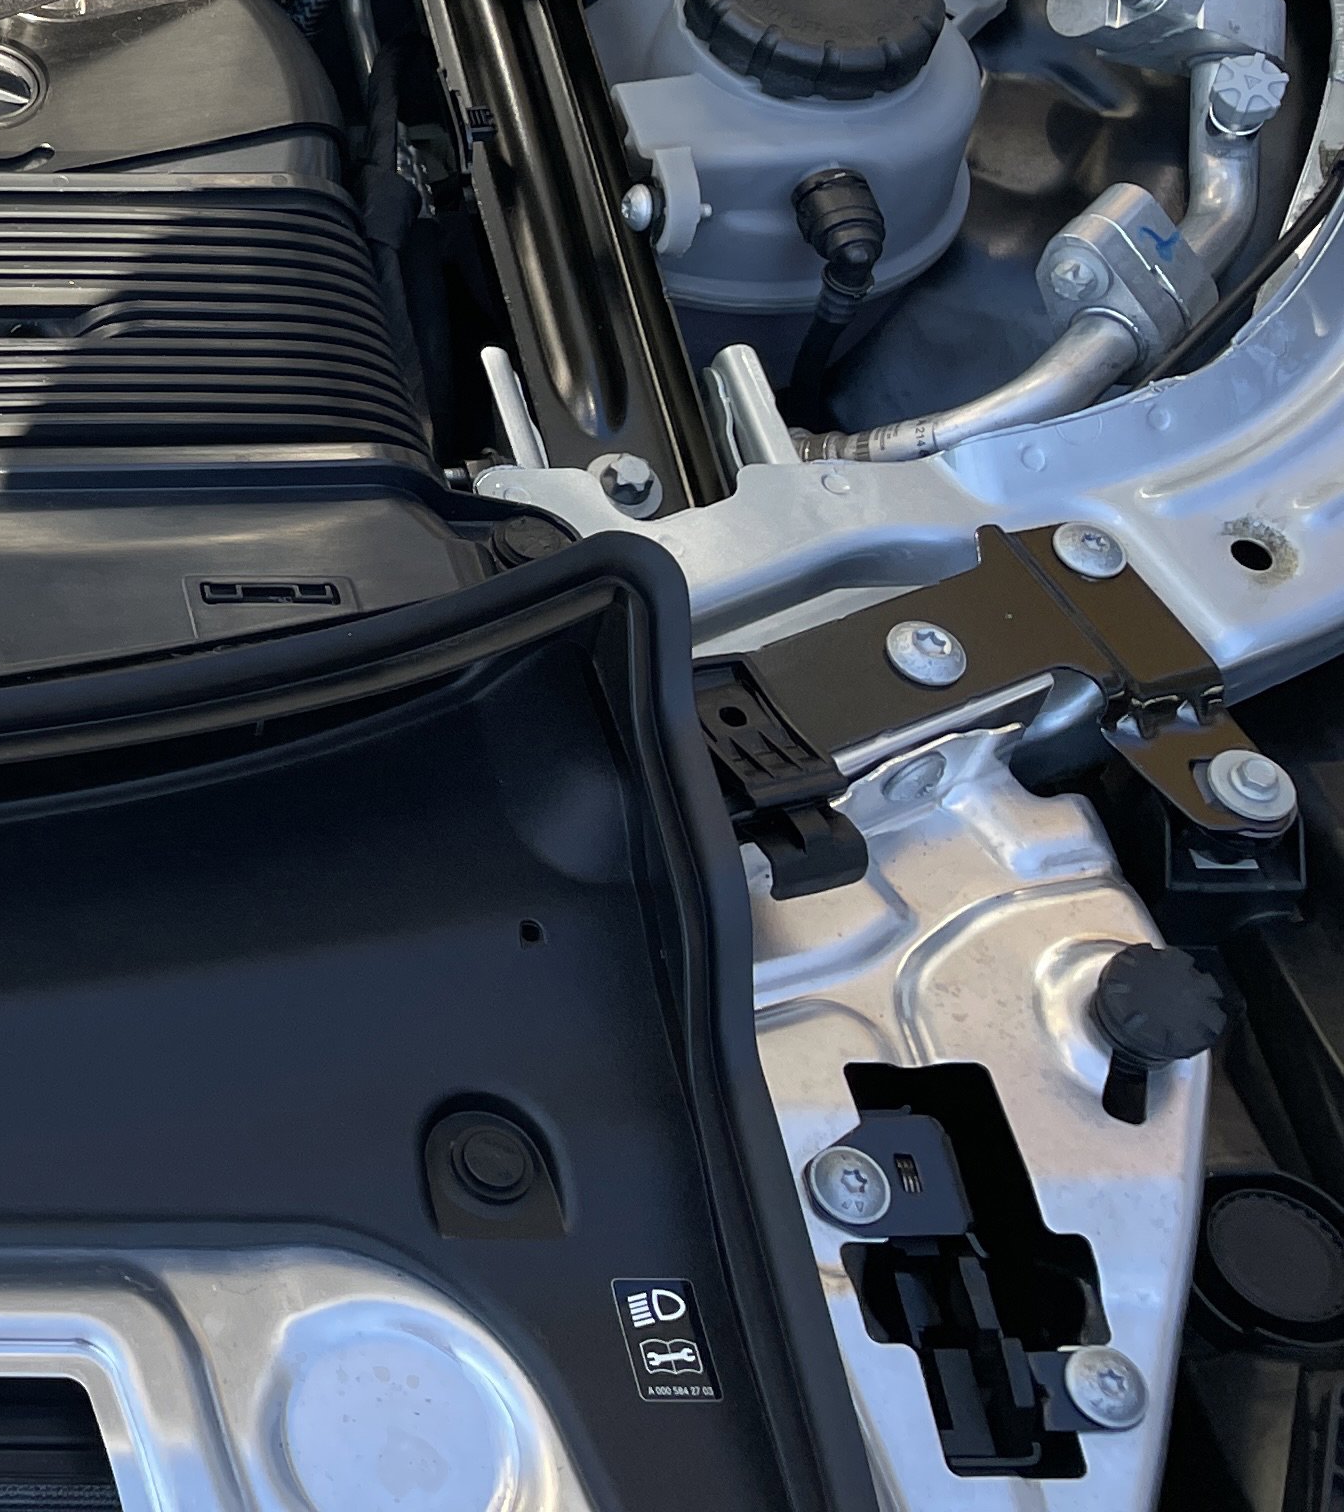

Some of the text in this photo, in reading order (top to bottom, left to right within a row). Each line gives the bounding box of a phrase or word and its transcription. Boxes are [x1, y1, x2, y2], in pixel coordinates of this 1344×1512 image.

[648, 1386, 656, 1395] A
[655, 1386, 672, 1396] 000
[673, 1386, 689, 1396] 584
[689, 1386, 700, 1396] 27
